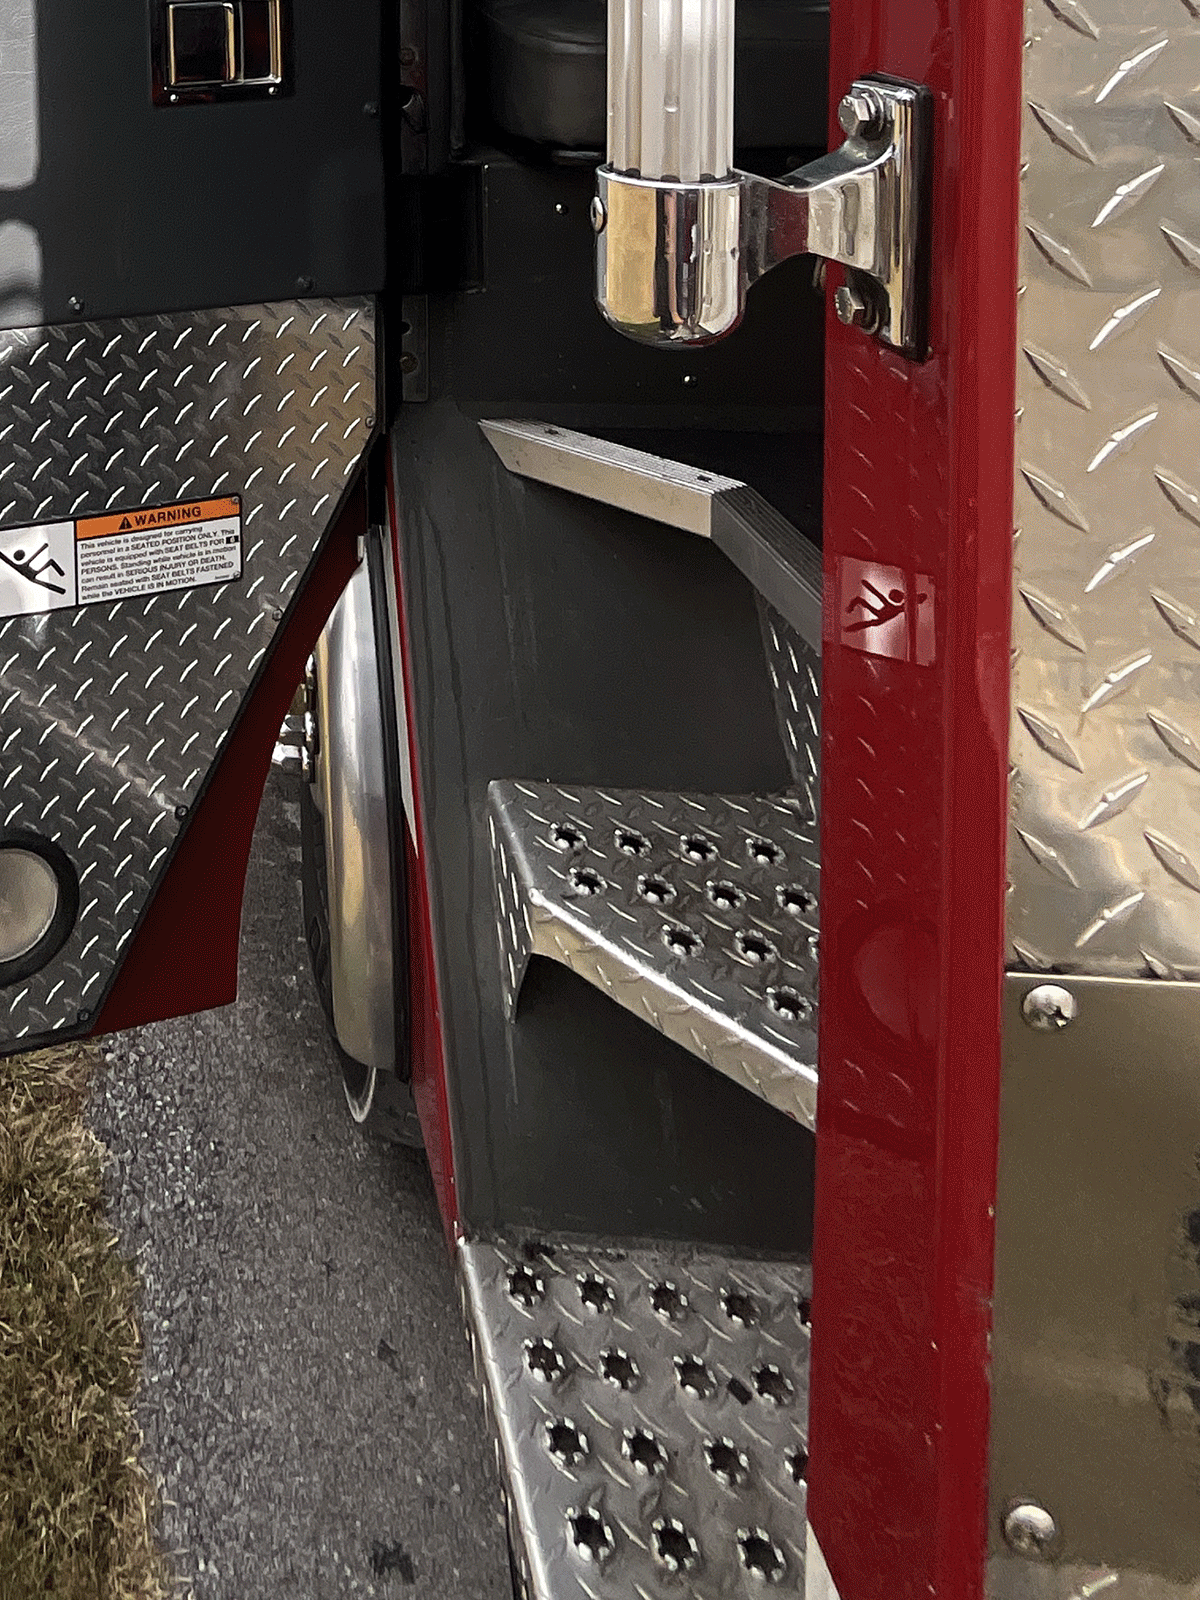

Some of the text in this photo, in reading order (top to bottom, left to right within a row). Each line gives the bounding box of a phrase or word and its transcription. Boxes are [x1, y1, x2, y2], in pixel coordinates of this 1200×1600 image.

[134, 506, 202, 526] WARNING
[81, 542, 95, 550] This
[97, 539, 122, 547] vehicle
[131, 531, 162, 542] designed
[175, 526, 203, 536] carrying
[81, 548, 115, 559] personnel
[131, 540, 160, 551] SEATED
[162, 535, 196, 545] POSITION
[198, 531, 218, 540] ONLY.
[81, 558, 106, 567] vehicle
[114, 551, 147, 563] equipped
[165, 545, 183, 553] SEAT
[185, 541, 208, 550] BELTS
[210, 538, 225, 546] FOR
[81, 564, 119, 575] PERSONS.
[120, 559, 151, 569] Standing
[153, 556, 171, 564] while
[172, 552, 196, 560] vehicle
[213, 546, 236, 554] motion
[81, 582, 108, 592] Remain
[110, 579, 133, 588] seated
[151, 572, 170, 581] SEAT
[172, 567, 195, 577] BELTS
[196, 561, 234, 573] FASTENED
[95, 573, 116, 581] result
[125, 566, 158, 577] SERIOUS
[160, 561, 186, 571] INJURY
[188, 558, 199, 566] OR
[200, 555, 226, 564] DEATH.
[115, 584, 146, 595] VEHICLE
[156, 580, 164, 588] IN
[166, 576, 196, 586] MOTION.
